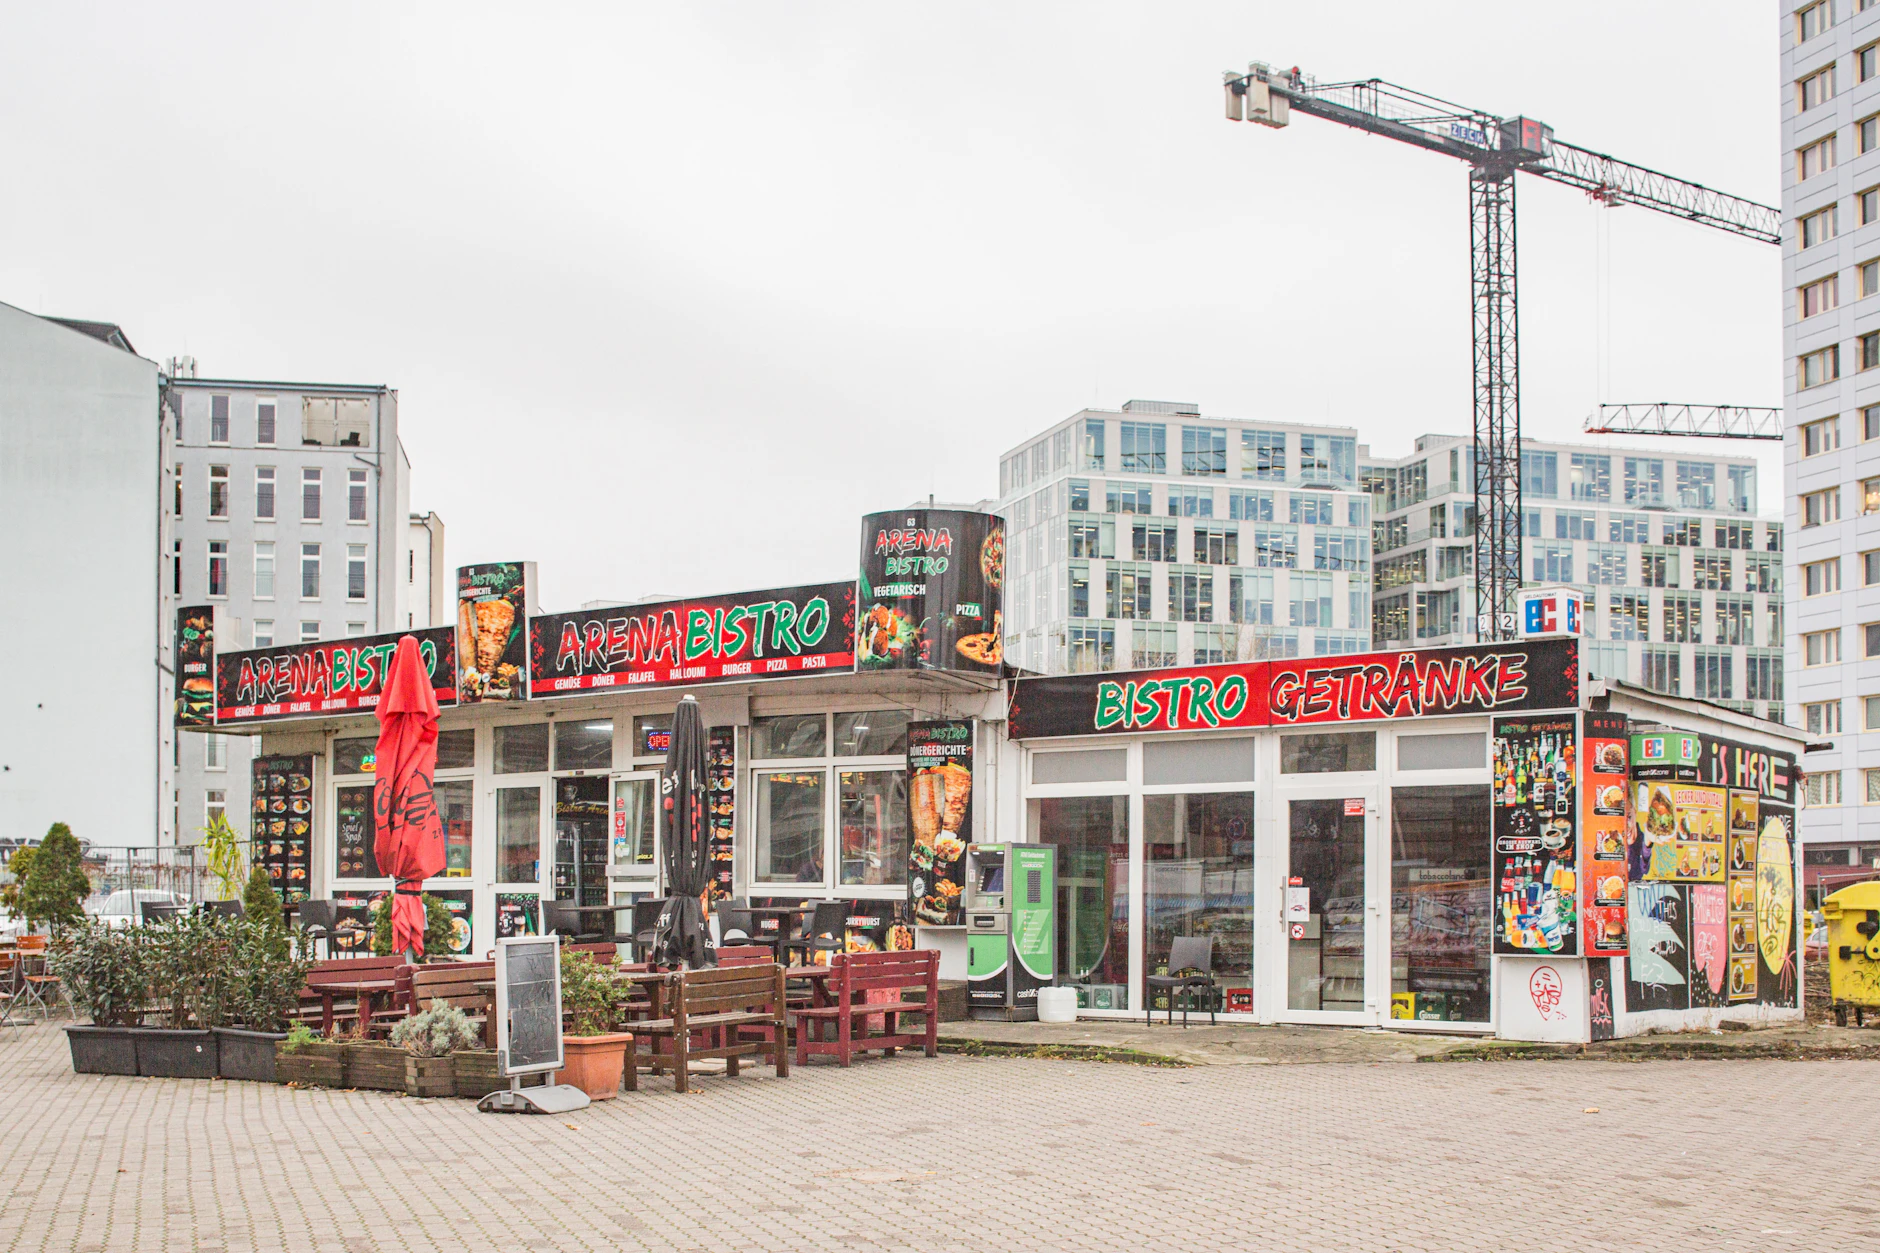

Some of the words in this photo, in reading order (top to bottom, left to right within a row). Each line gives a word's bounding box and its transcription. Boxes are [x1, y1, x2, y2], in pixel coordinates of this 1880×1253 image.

[1451, 123, 1485, 144] ZECH
[907, 518, 916, 526] 63
[875, 527, 953, 556] ARENA
[885, 555, 948, 576] BISTRO
[874, 584, 926, 597] VEGETARISCH
[956, 603, 980, 616] PIZZA
[1503, 615, 1512, 628] 2
[184, 663, 207, 673] BURGER
[554, 675, 581, 690] GEMÜSE
[591, 673, 615, 687] DÖNER
[628, 671, 656, 683] FALAFEL
[669, 666, 706, 680] HALLOUMI
[721, 663, 752, 675] BURGER
[766, 659, 788, 672] PIZZA
[802, 655, 827, 668] PASTA
[1095, 676, 1248, 729] BISTRO
[1269, 653, 1530, 722] GETRÄNKE
[234, 704, 256, 717] GEMÜSE
[262, 703, 281, 715] DÖNER
[930, 727, 968, 740] BISTRO
[648, 735, 671, 748] OPE
[910, 744, 967, 757] DÖNERGERICHTE
[1735, 747, 1788, 801] HERE
